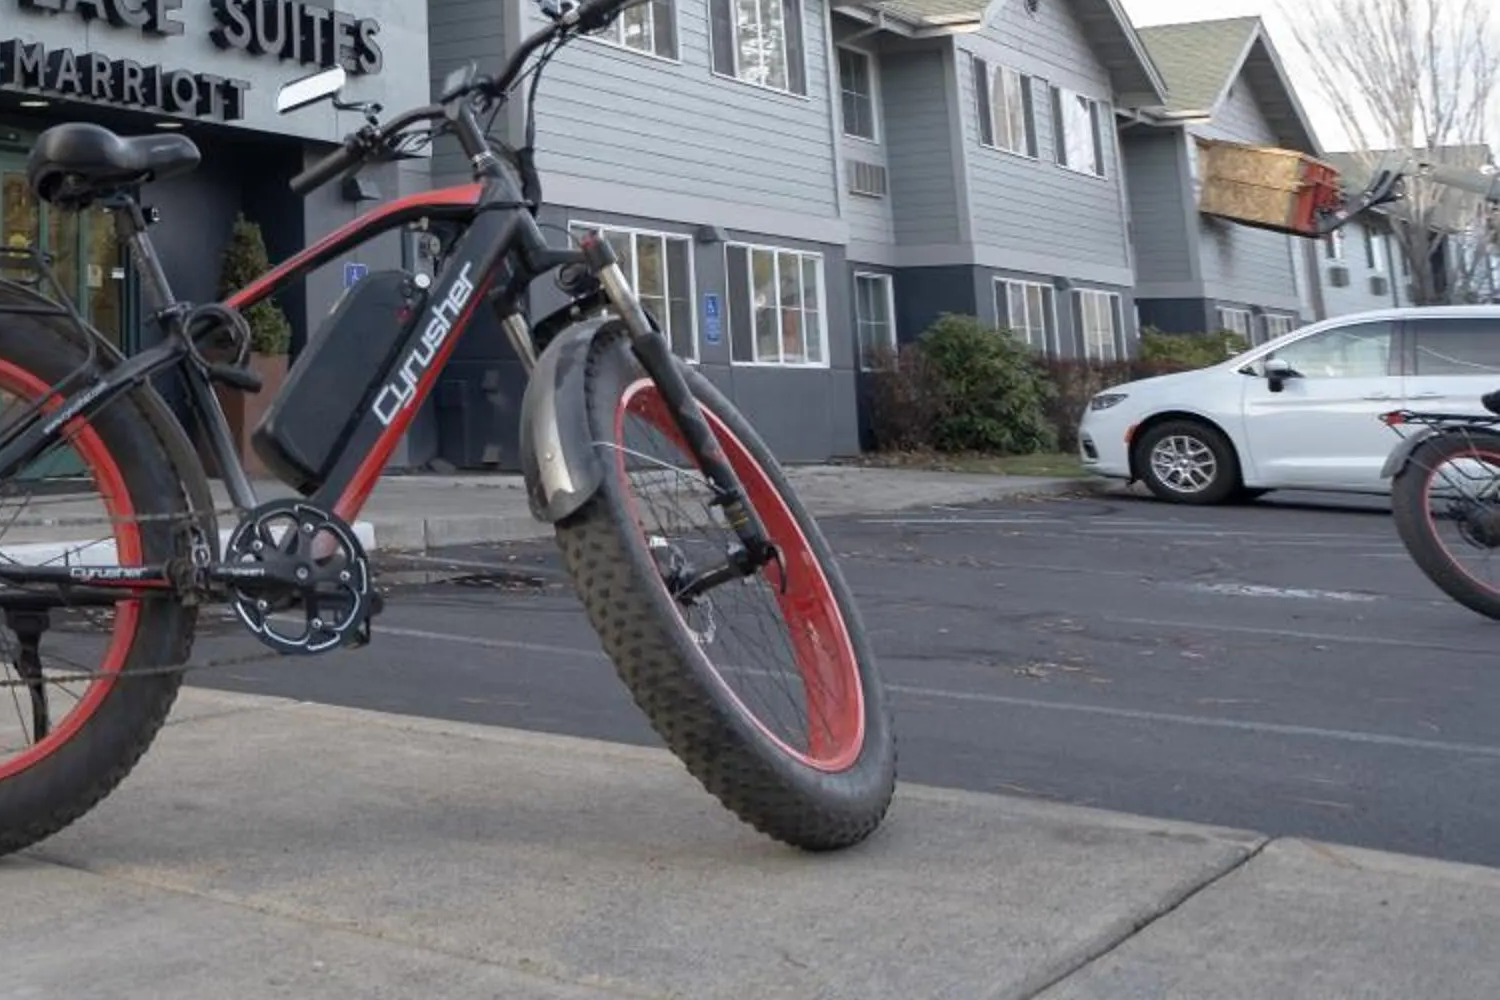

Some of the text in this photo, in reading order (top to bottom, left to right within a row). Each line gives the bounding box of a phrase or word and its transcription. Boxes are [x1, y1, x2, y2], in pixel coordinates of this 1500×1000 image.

[0, 37, 252, 122] MARRIOTT
[372, 261, 475, 427] Cyrusher
[70, 567, 149, 582] Cyrusher
